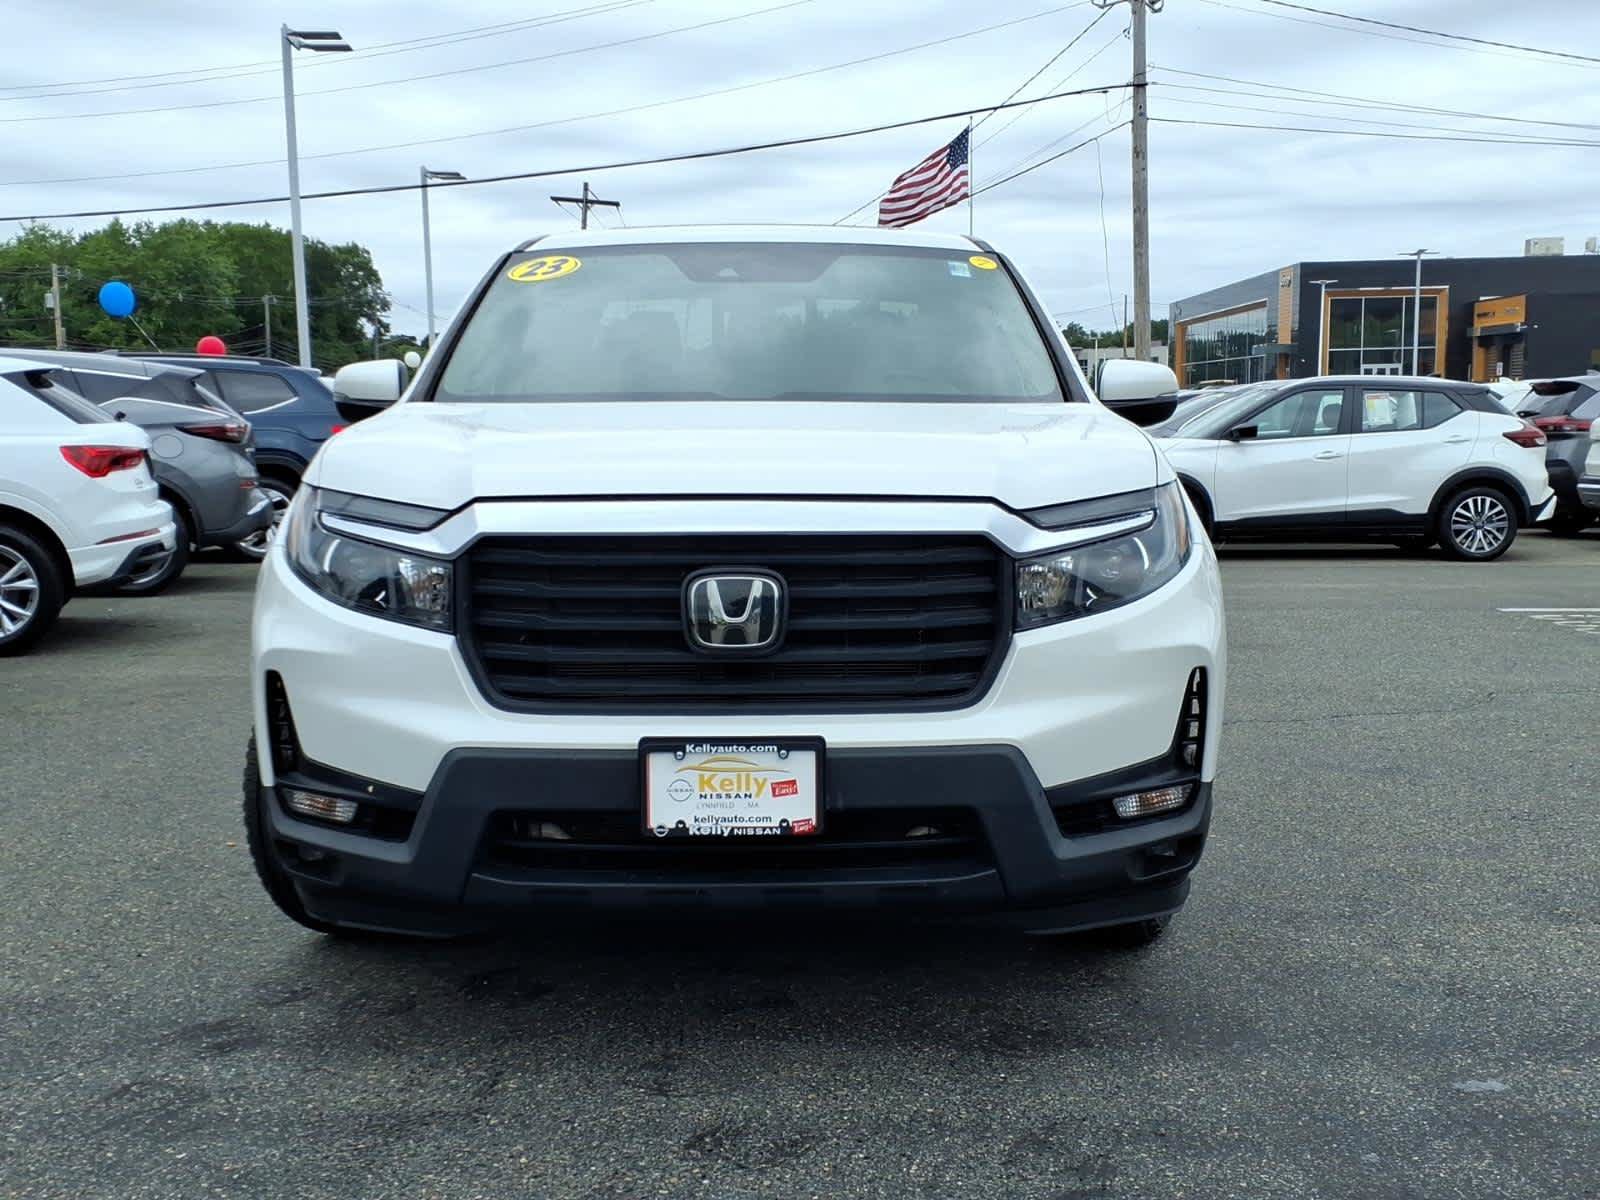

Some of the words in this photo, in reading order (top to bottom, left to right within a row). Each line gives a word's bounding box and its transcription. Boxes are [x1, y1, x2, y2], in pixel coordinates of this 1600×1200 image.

[517, 257, 570, 278] 23
[685, 743, 778, 756] Kellyauto.com
[698, 773, 768, 798] Kelly
[694, 815, 772, 825] kellyauto.com
[688, 823, 731, 837] Kelly
[734, 827, 781, 835] NISSAN
